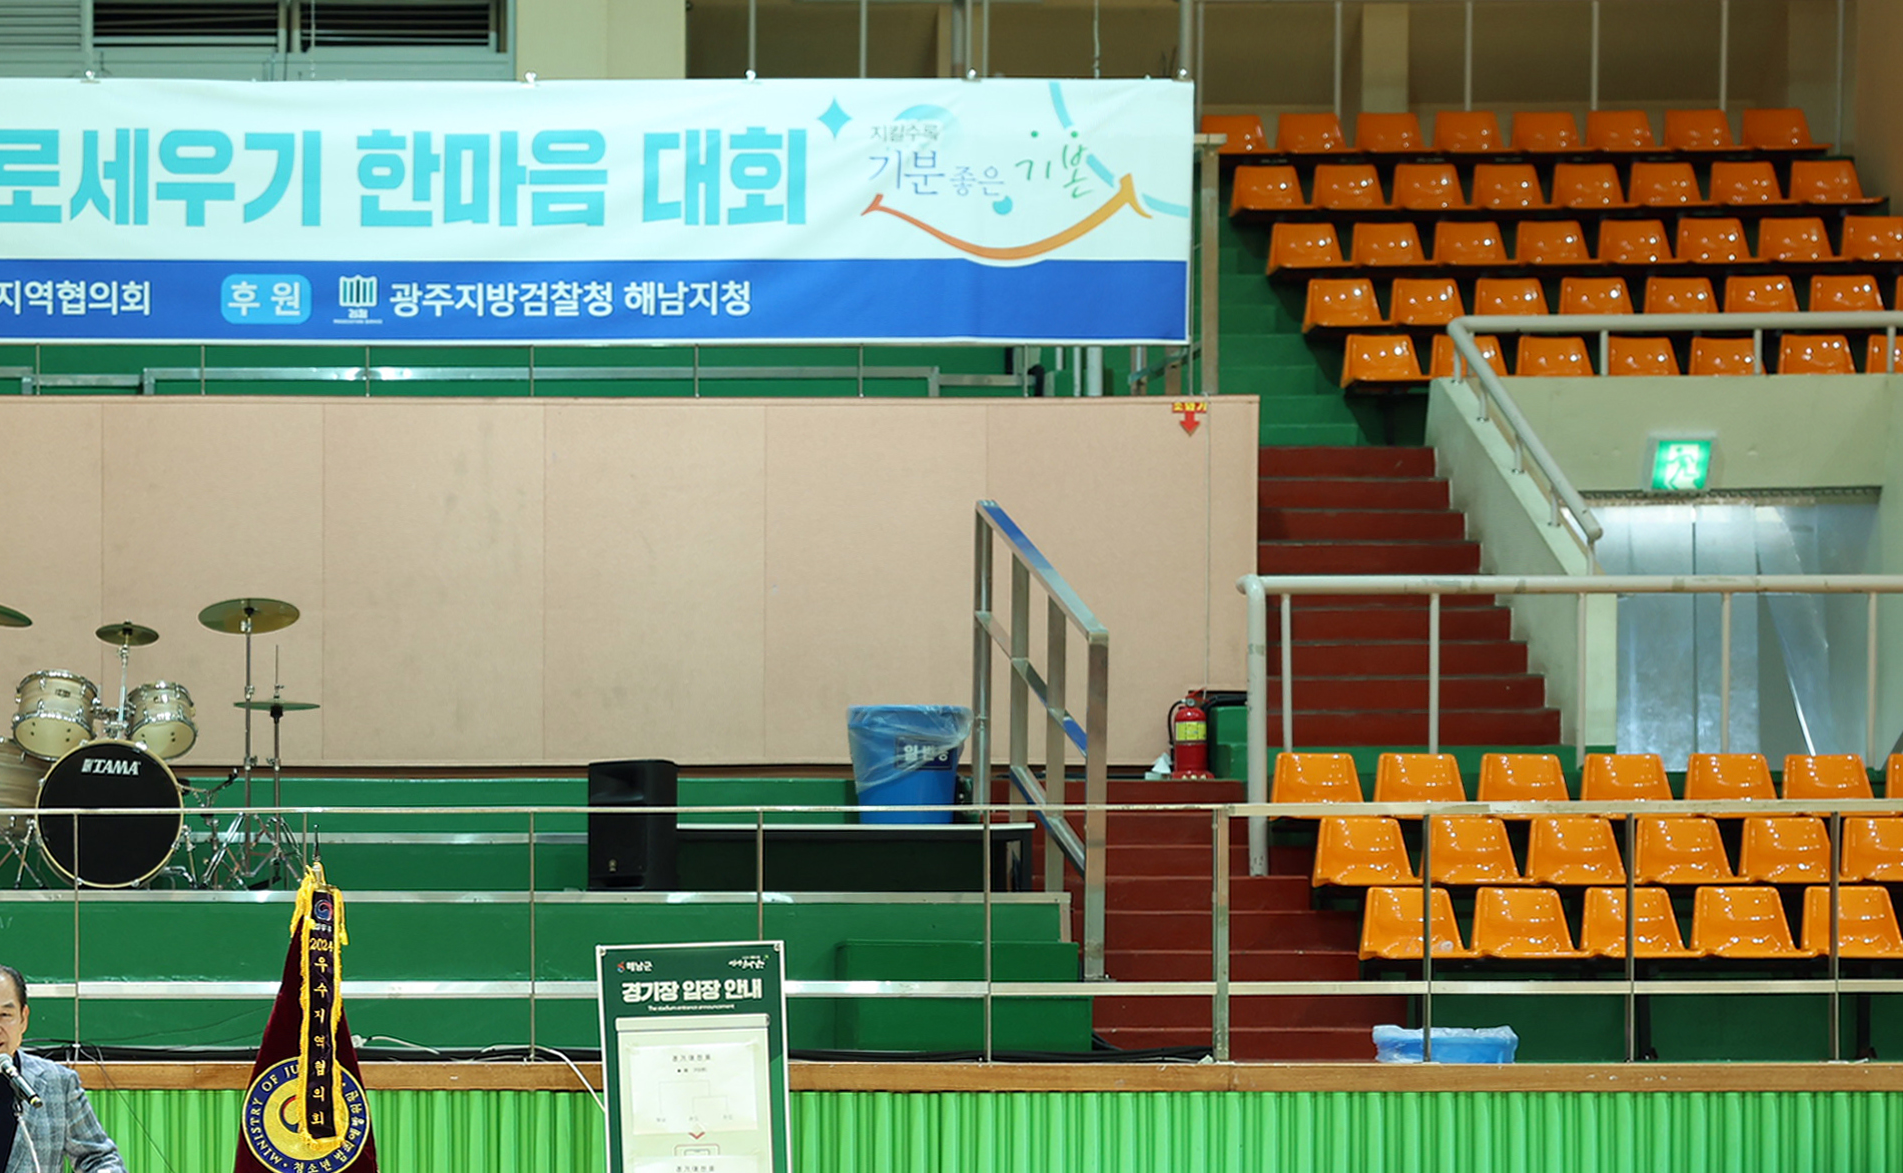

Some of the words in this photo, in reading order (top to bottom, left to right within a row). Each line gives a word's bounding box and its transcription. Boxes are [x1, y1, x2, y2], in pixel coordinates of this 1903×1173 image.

[356, 128, 608, 227] 한마음
[642, 126, 807, 226] 대회
[868, 150, 945, 195] 기분
[950, 165, 1005, 197] 좋은
[1015, 144, 1094, 199] 기본
[389, 281, 614, 319] 광주지방검찰청
[623, 280, 752, 317] 해남지청
[92, 759, 139, 776] TAMA
[622, 981, 680, 1003] 경기장
[682, 979, 722, 1001] 입장
[724, 978, 763, 1000] 안내
[311, 956, 329, 1126] 우수지역협의회
[261, 1074, 279, 1092] OF
[250, 1098, 283, 1165] MINISTRY
[333, 1090, 365, 1163] 범죄예방위원
